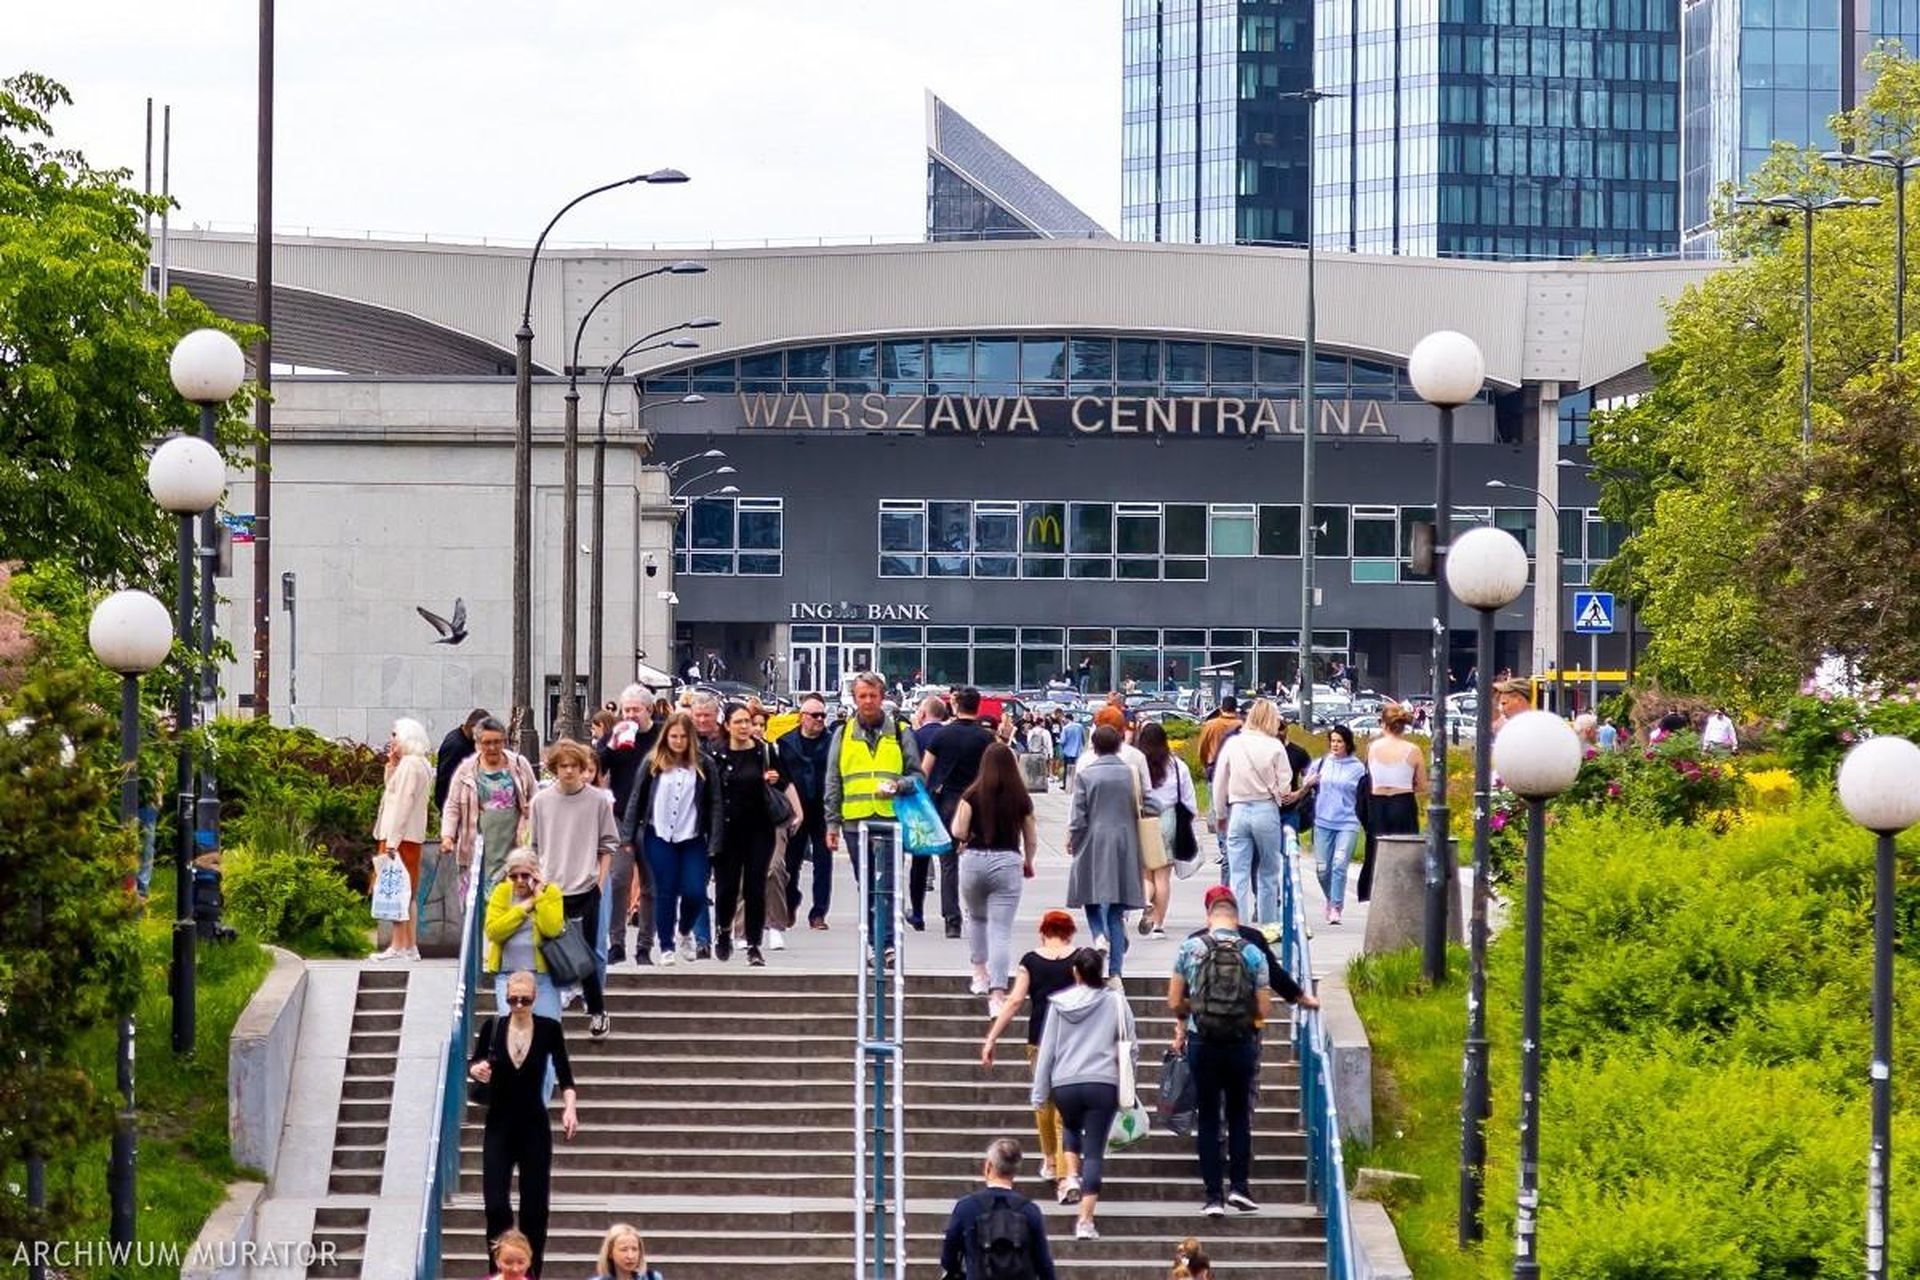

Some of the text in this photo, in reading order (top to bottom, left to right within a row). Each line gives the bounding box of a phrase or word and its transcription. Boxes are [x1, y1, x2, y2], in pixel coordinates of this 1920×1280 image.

[740, 392, 1388, 434] WARSZAWA CENTRALNA
[790, 602, 931, 620] ING BANK
